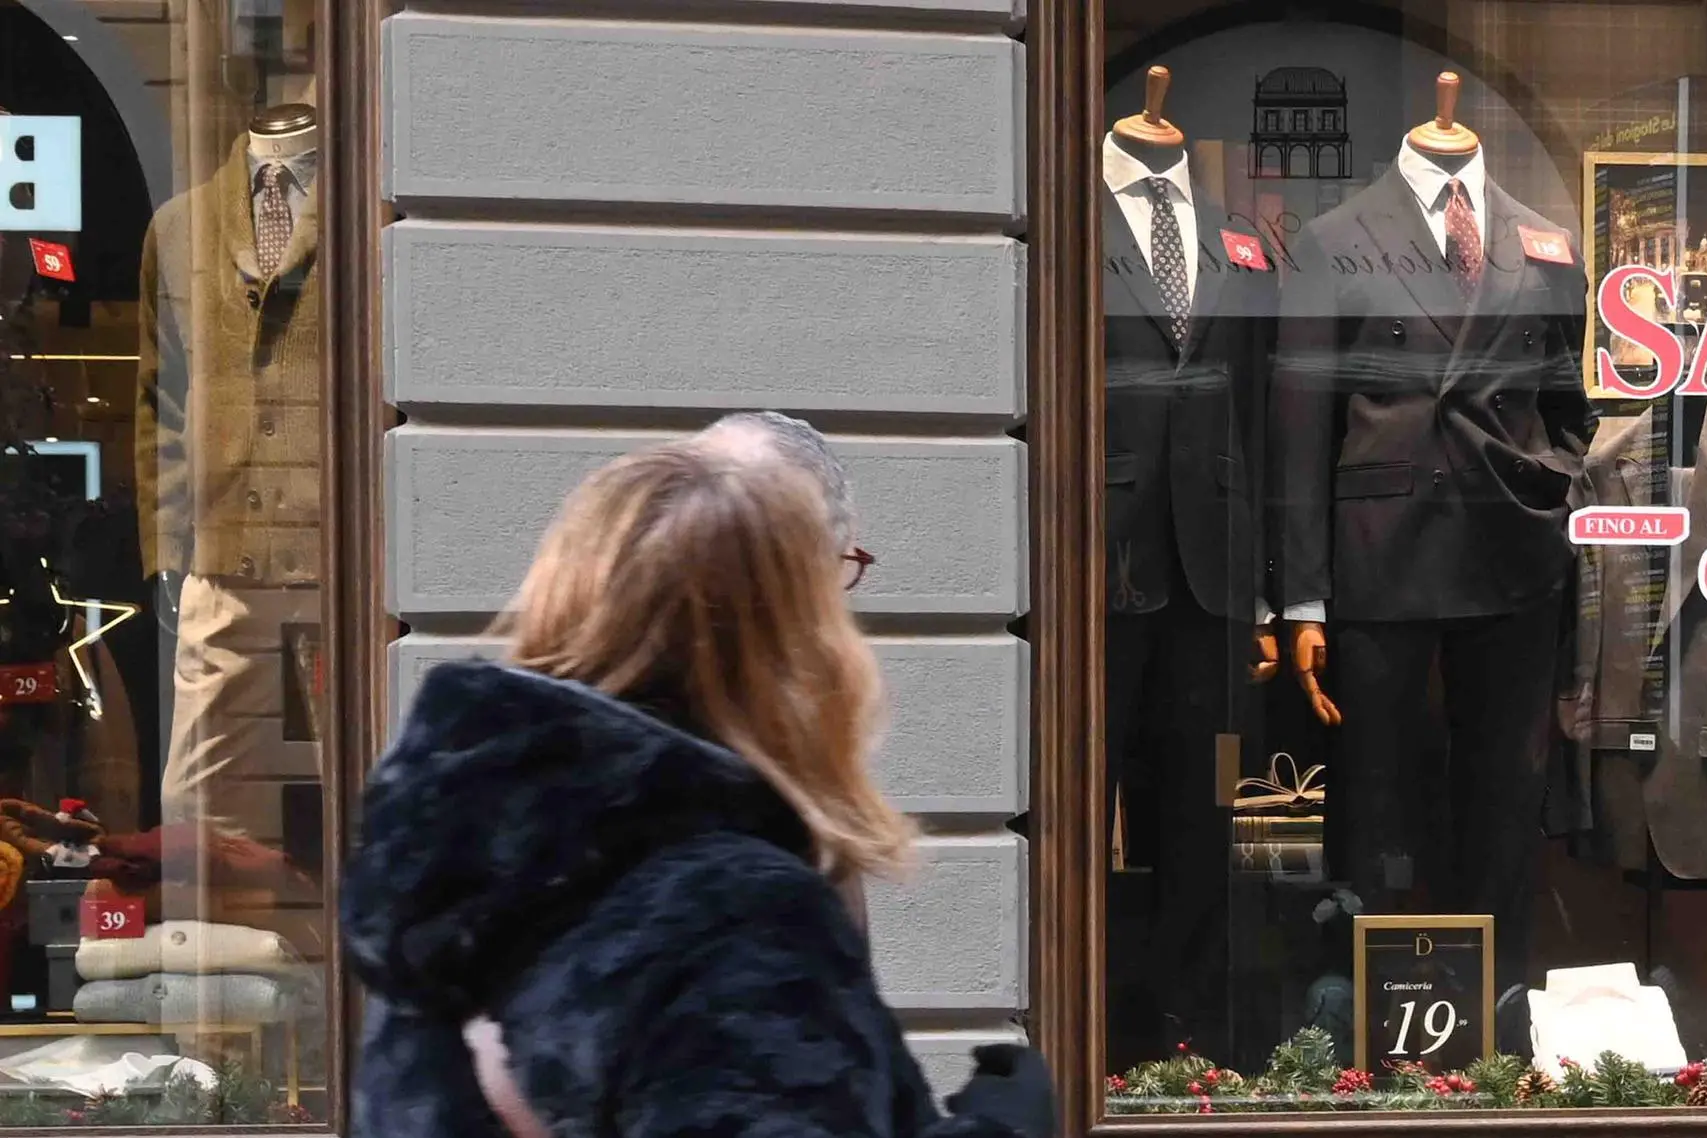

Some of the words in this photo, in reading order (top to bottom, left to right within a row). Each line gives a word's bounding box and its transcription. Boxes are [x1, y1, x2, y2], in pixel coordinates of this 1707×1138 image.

[1585, 518, 1635, 534] FINO
[1640, 518, 1668, 535] AL
[15, 676, 37, 696] 29
[100, 911, 126, 930] 39
[1383, 981, 1433, 991] Camiceria
